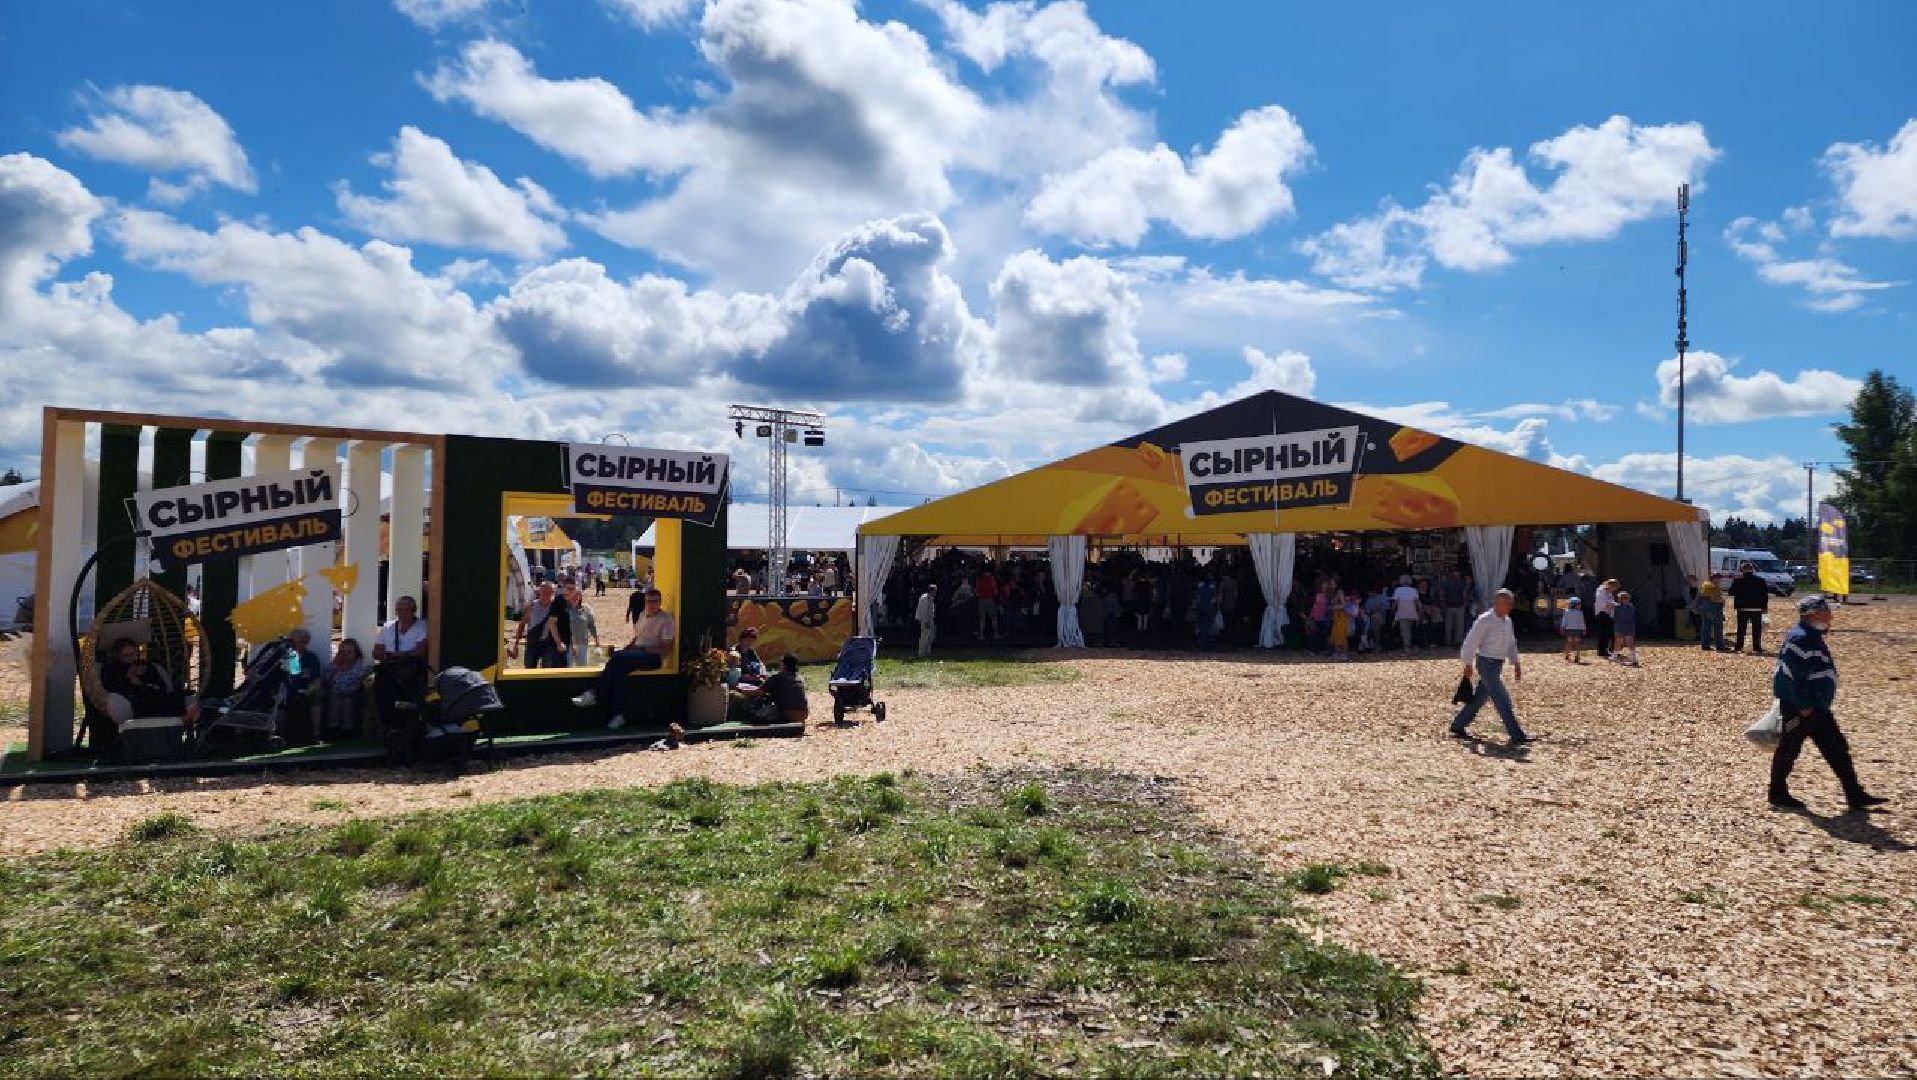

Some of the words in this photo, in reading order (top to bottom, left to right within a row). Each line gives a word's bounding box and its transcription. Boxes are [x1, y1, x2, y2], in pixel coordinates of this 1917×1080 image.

[576, 453, 716, 485] СЫРНЫЙ
[1189, 431, 1347, 477] СЫРНЫЙ
[149, 469, 332, 527] СЫРНЫЙ
[586, 490, 706, 513] ФЕСТИВАЛЬ
[1204, 479, 1338, 506] ФЕСТИВАЛЬ
[172, 518, 328, 558] ФЕСТИВАЛЬ
